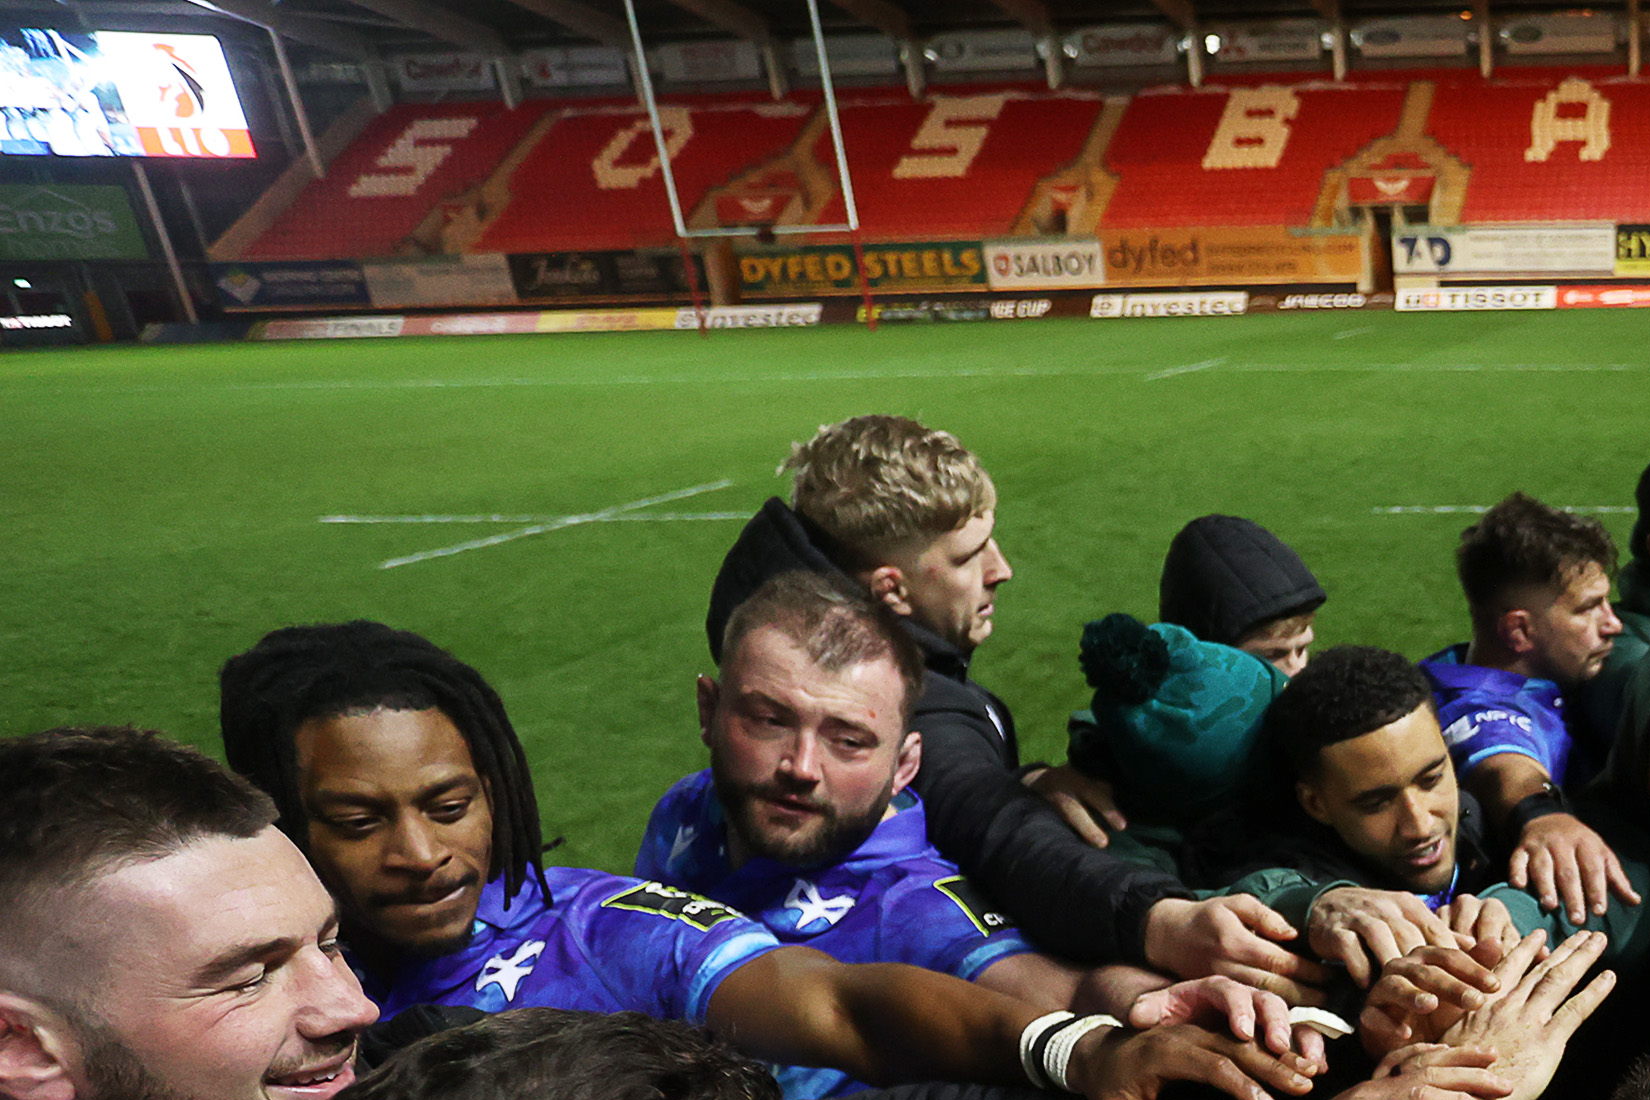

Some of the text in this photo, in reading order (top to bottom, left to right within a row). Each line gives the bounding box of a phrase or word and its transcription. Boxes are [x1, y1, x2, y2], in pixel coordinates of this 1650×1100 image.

[740, 249, 981, 284] DYFED STEELS
[1013, 250, 1098, 277] SALBOY
[1108, 234, 1199, 274] dyfed
[1448, 291, 1546, 308] TISSOT
